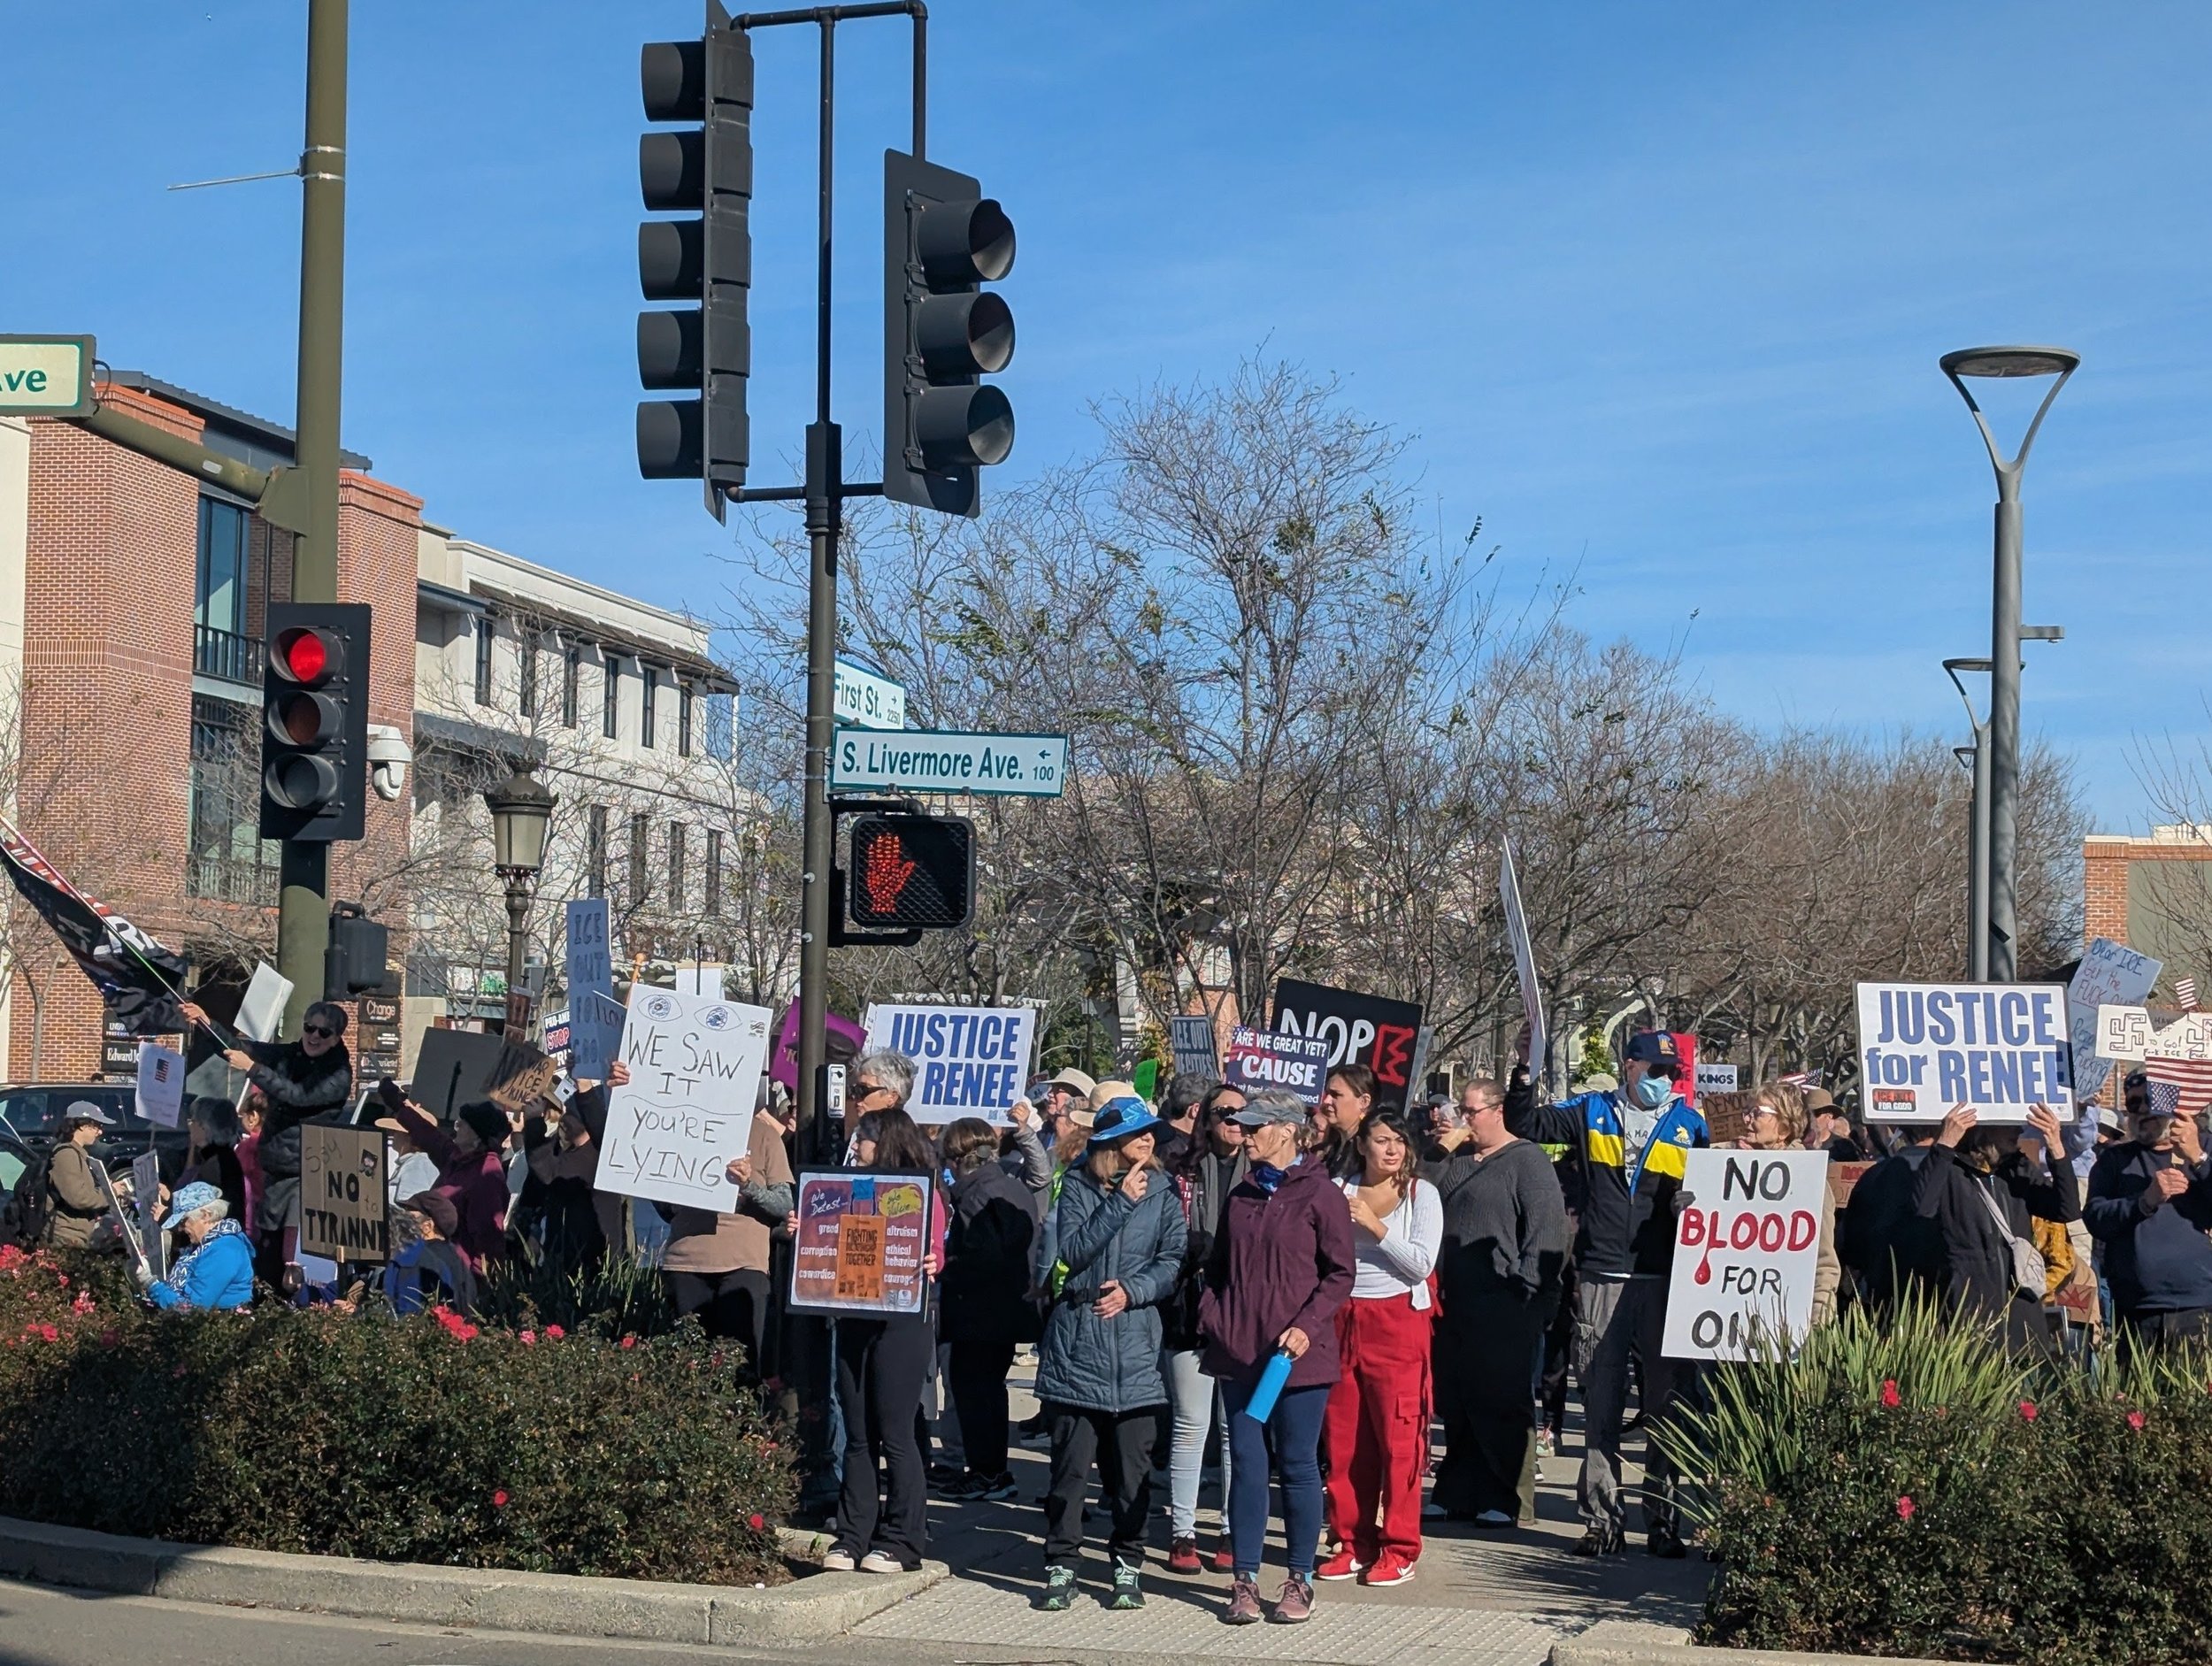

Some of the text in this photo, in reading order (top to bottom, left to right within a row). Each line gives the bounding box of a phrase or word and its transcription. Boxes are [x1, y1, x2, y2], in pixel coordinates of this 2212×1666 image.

[0, 369, 47, 392] ve
[865, 686, 881, 718] St.
[842, 741, 1023, 779] S. Livermore Ave.
[1033, 765, 1054, 781] 100
[574, 913, 602, 944] ICE
[2116, 948, 2147, 976] ICE
[2076, 979, 2108, 1006] FUCK
[366, 1000, 396, 1018] Change
[1878, 990, 2055, 1046] JUSTICE
[547, 1027, 570, 1050] STOP
[890, 1013, 1021, 1060] JUSTICE
[1235, 1031, 1327, 1058] ARE WE GREAT YET?
[107, 1048, 132, 1063] Edward
[628, 1022, 745, 1080] WE SAW
[519, 1072, 542, 1093] ICE
[1237, 1051, 1318, 1087] 'CAUSE
[1698, 1073, 1734, 1085] KINGS
[1864, 1047, 2067, 1104] for RENEE
[657, 1072, 701, 1096] IT
[921, 1062, 1018, 1108] RENEE
[632, 1107, 727, 1143] YOU'RE
[609, 1138, 722, 1187] LYING
[327, 1171, 359, 1202] NO
[1723, 1157, 1791, 1202] NO
[818, 1223, 840, 1235] greed
[887, 1225, 918, 1237] altruism
[1680, 1208, 1816, 1252] BLOOD
[800, 1245, 837, 1257] corruption
[846, 1253, 876, 1266] TOGETHER
[886, 1243, 911, 1255] ethical
[886, 1255, 918, 1268] behavior
[799, 1268, 836, 1280] cowardice
[884, 1272, 915, 1286] courage
[1722, 1266, 1782, 1295] FOR
